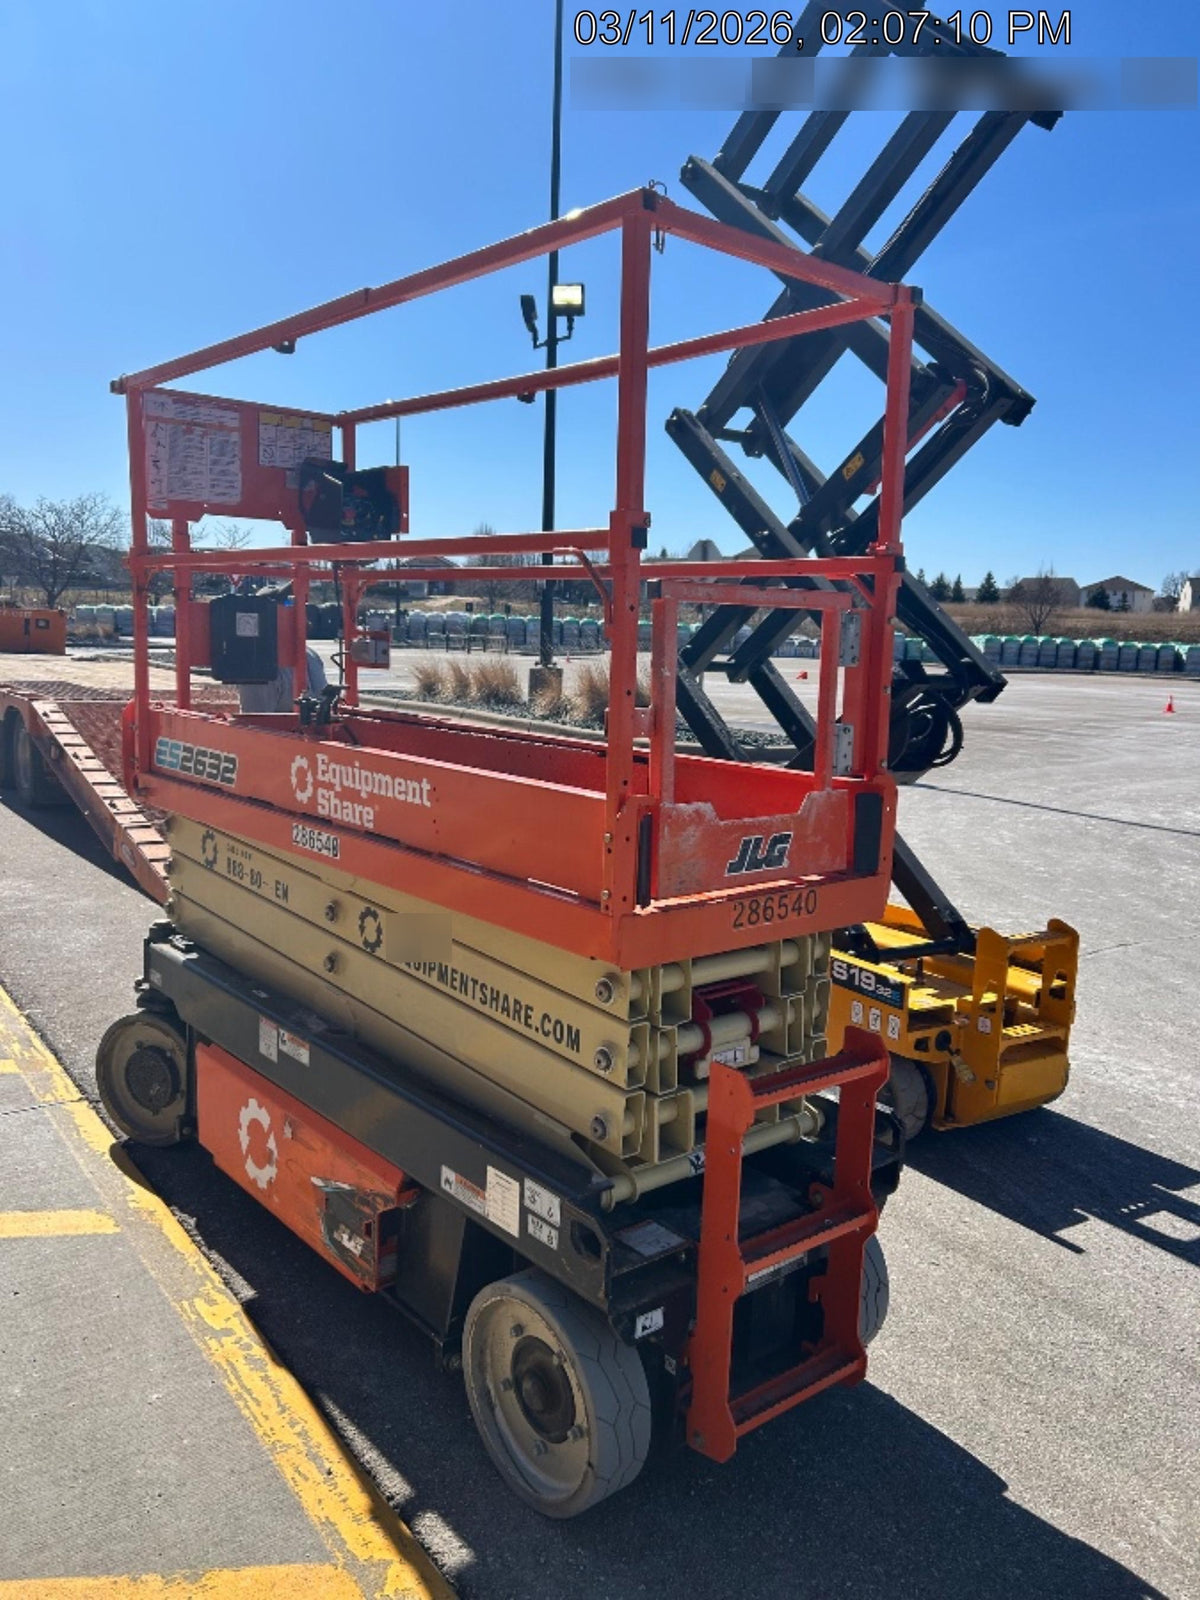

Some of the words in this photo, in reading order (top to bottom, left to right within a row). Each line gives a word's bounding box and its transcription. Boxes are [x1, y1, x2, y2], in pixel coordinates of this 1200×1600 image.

[315, 754, 432, 807] Equipment
[316, 788, 375, 828] Share
[725, 832, 793, 876] JLG
[732, 890, 818, 928] 286540
[403, 962, 581, 1053] IPMENTSHARE.COM
